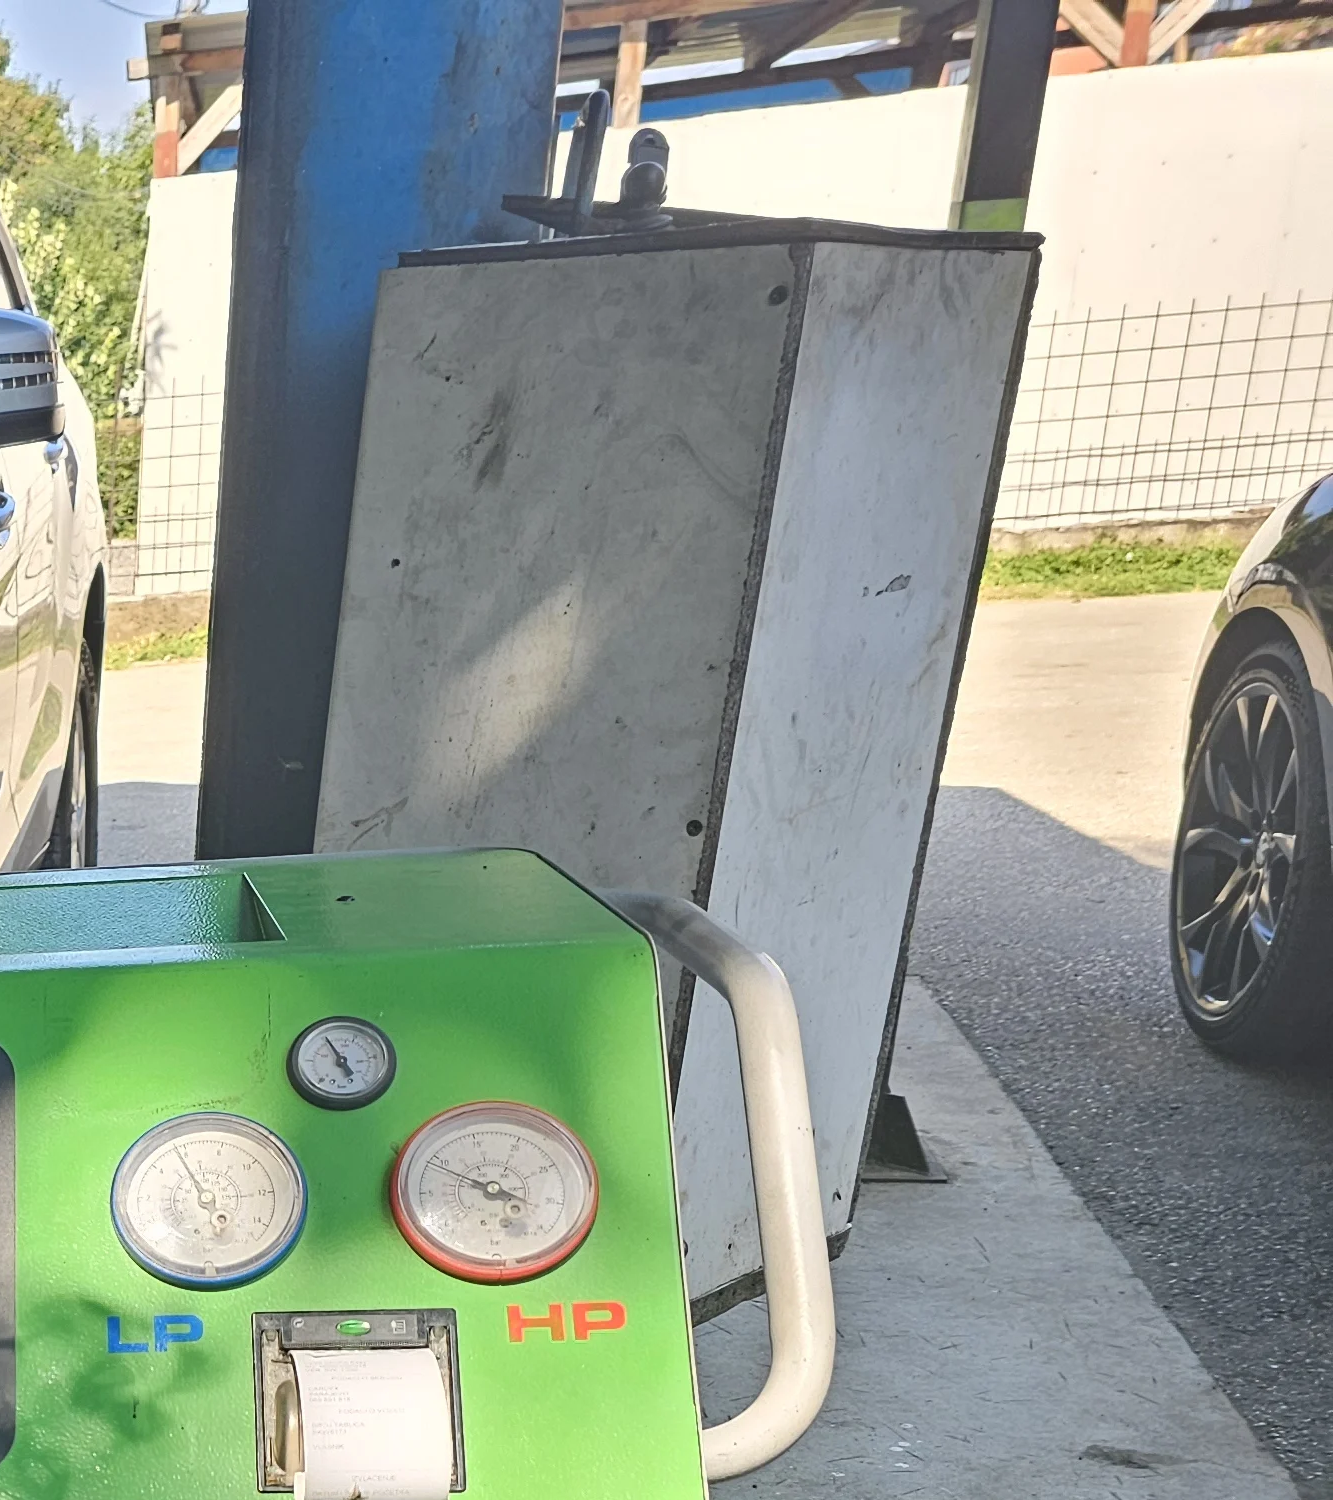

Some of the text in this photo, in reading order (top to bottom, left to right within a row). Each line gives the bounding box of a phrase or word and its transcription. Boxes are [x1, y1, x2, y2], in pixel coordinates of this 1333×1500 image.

[510, 1144, 520, 1152] 20
[242, 1163, 251, 1171] 10
[440, 1159, 450, 1167] 10
[538, 1166, 549, 1174] 25
[258, 1189, 267, 1197] 12
[545, 1197, 555, 1205] 30
[506, 1302, 627, 1343] HP
[107, 1314, 204, 1353] LP
